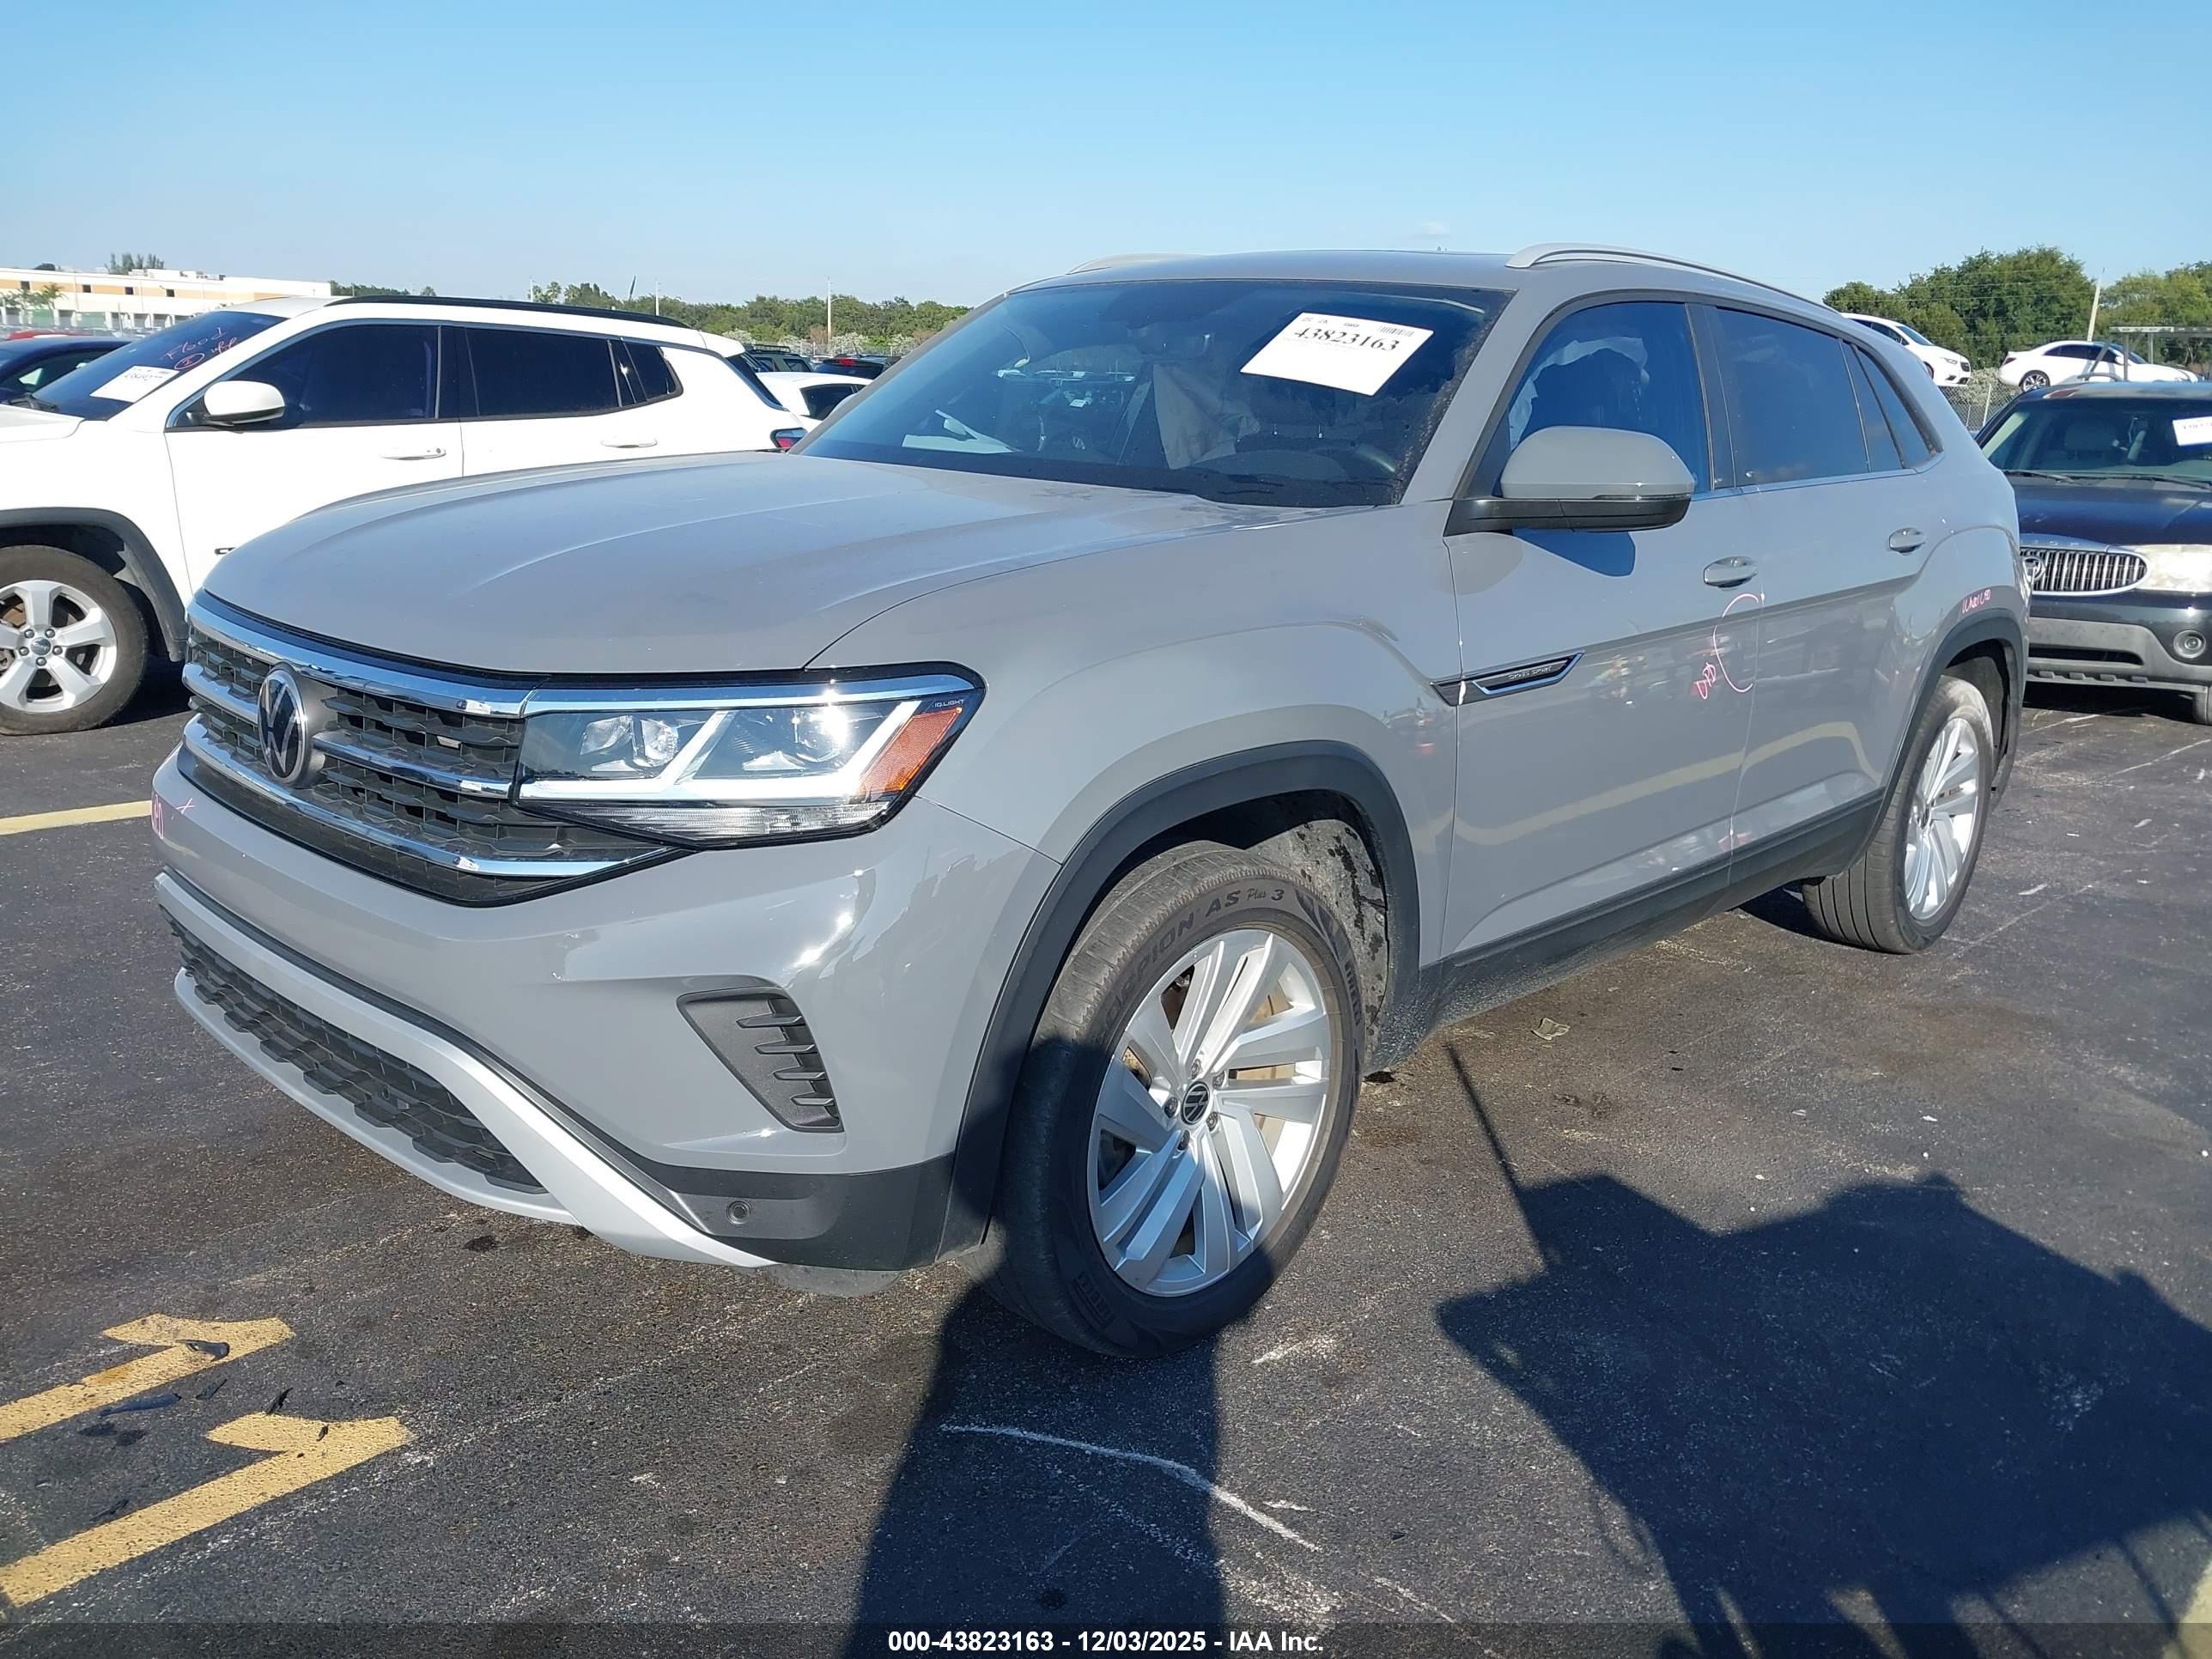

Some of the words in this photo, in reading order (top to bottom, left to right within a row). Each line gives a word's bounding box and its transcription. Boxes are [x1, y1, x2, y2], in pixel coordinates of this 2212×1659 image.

[159, 327, 226, 361] Flood
[1294, 327, 1400, 350] 43823163
[1205, 889, 1243, 920] AS
[1247, 887, 1267, 901] Plus
[1271, 889, 1285, 901] 3
